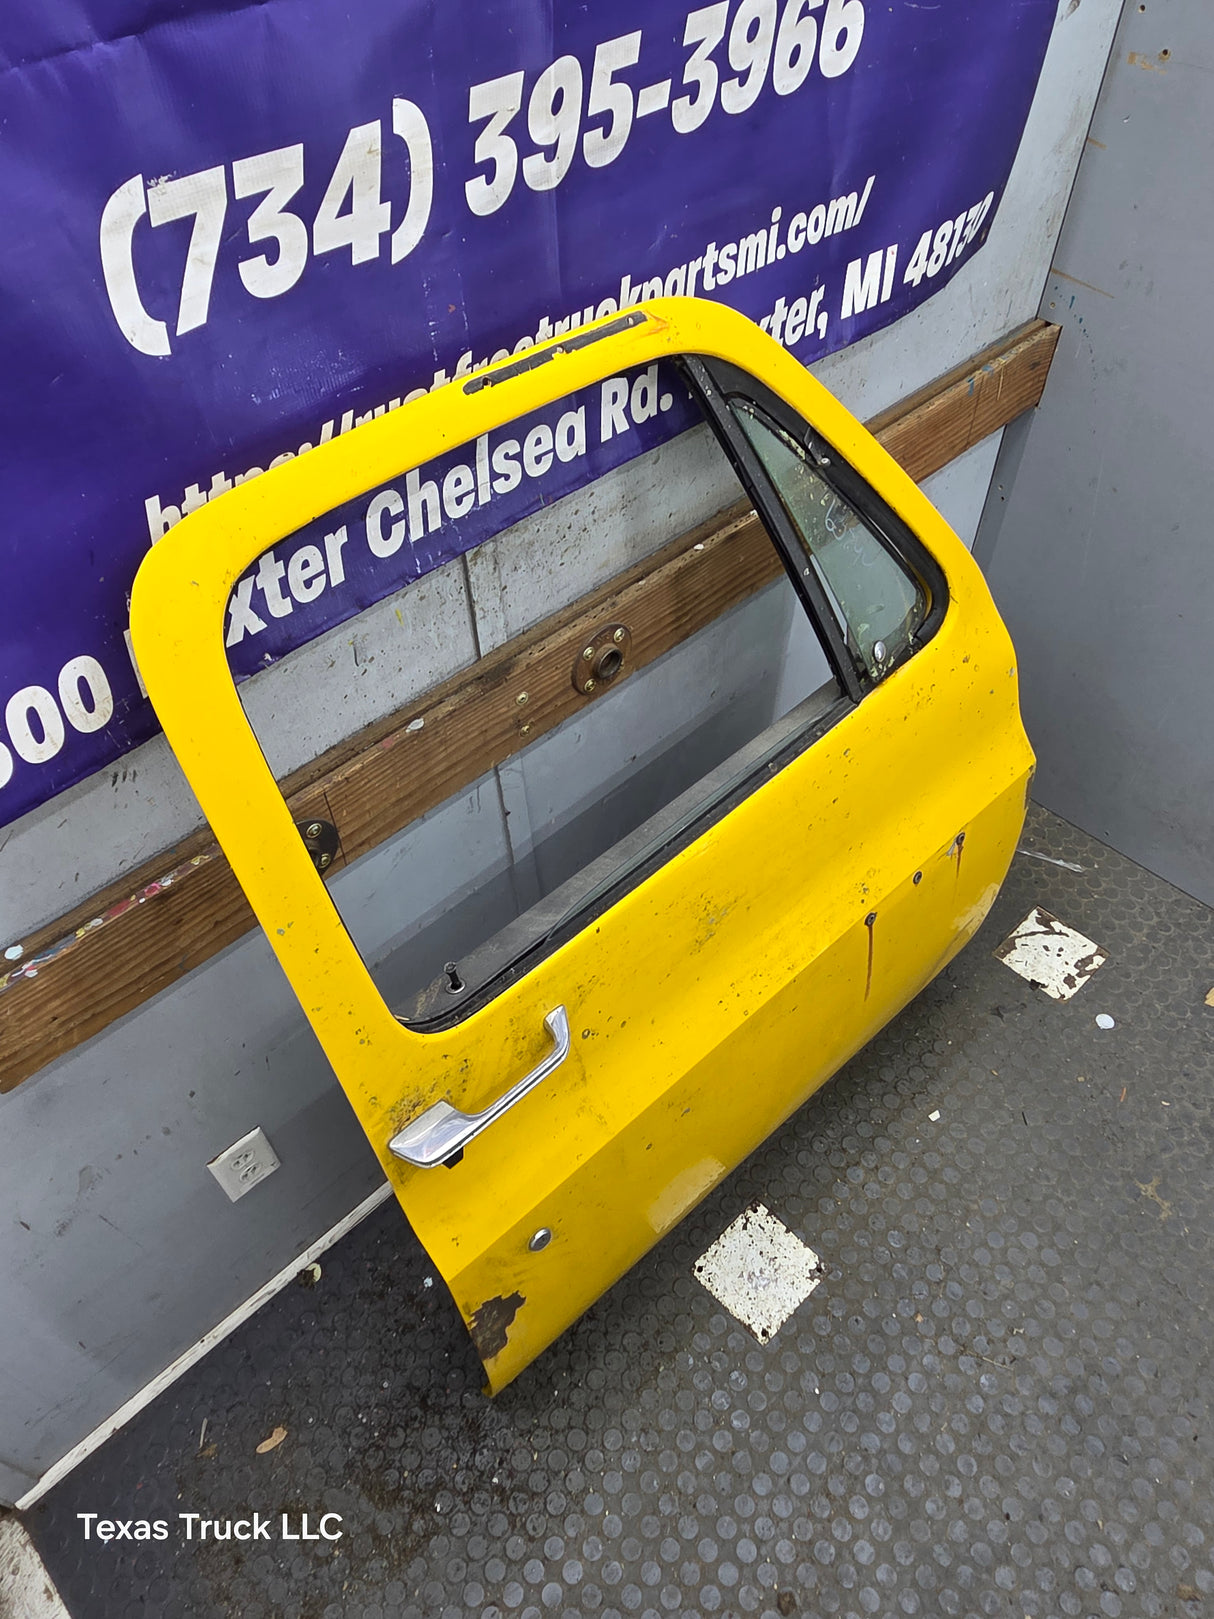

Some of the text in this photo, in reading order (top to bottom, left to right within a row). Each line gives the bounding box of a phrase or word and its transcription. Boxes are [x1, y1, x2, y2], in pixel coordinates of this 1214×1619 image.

[100, 0, 866, 356] (734) 395-3966
[366, 405, 586, 558] Chelsea
[601, 364, 673, 442] Rd.
[840, 243, 899, 320] MI
[903, 190, 995, 288] 48130
